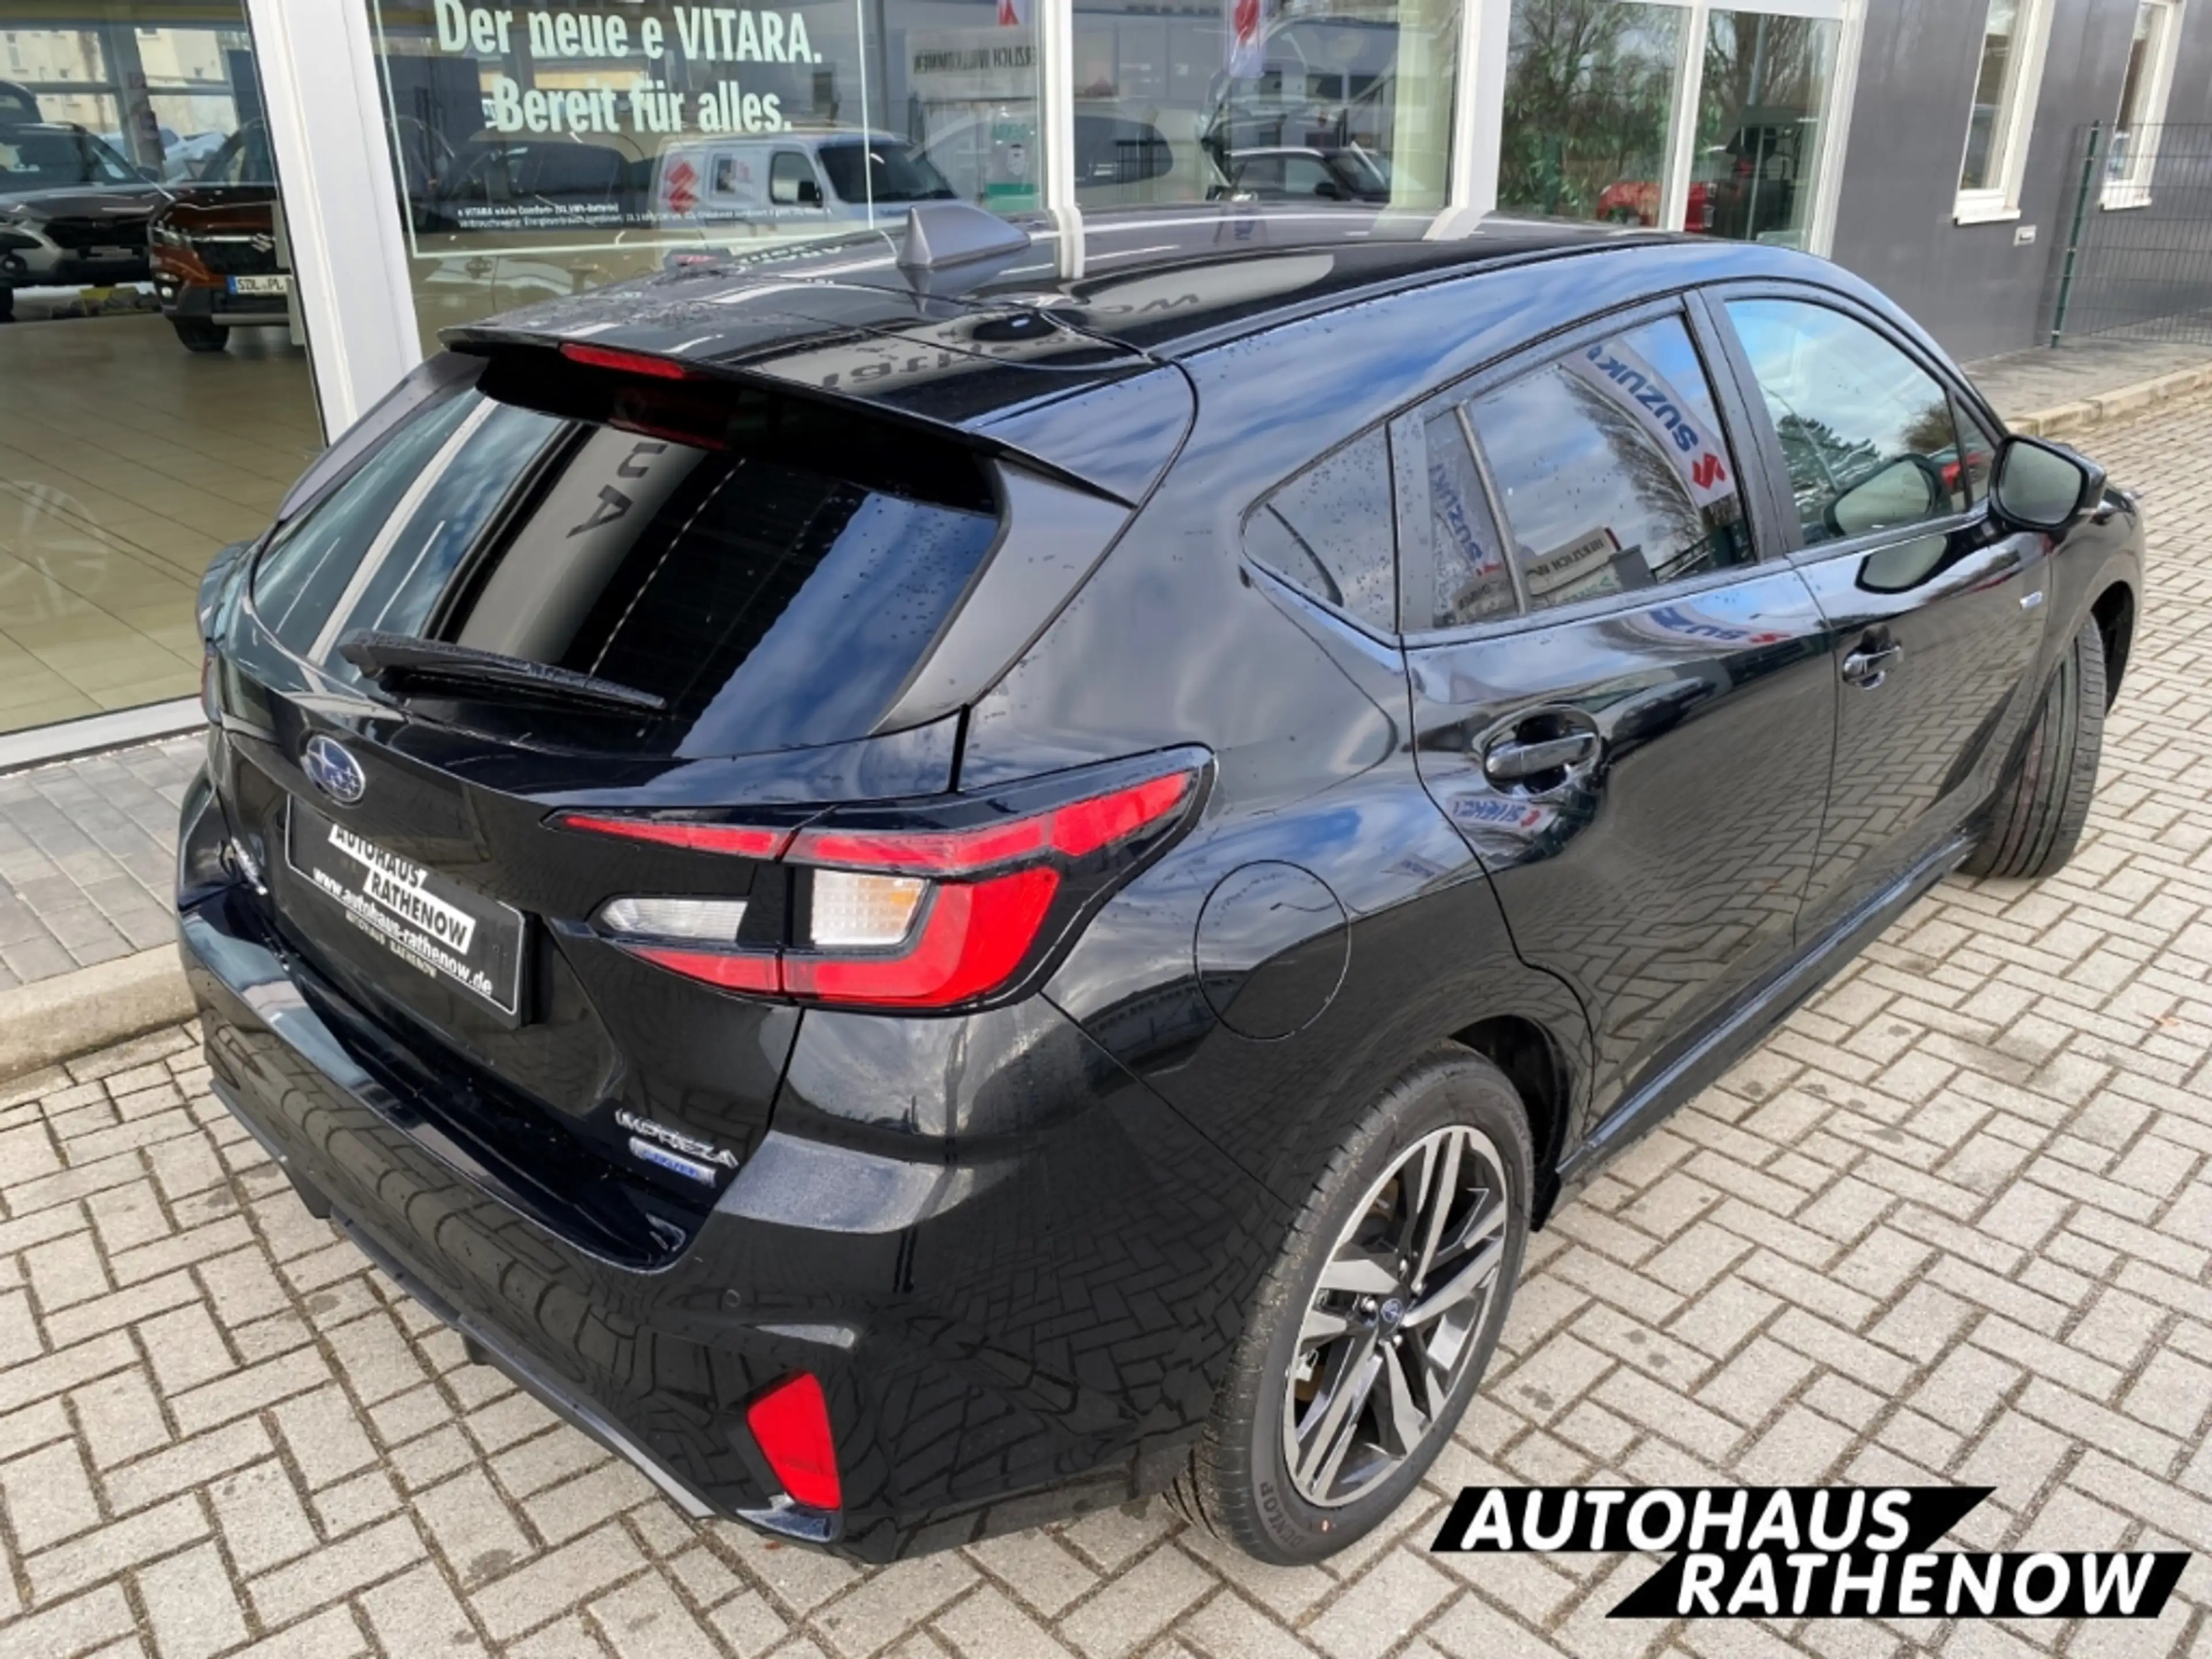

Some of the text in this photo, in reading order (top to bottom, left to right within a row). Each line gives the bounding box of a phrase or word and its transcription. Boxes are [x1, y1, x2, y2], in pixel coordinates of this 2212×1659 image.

[434, 0, 822, 63] Der neue e VITARA.
[491, 76, 792, 132] Bereit für alles.
[336, 825, 419, 889] AUTOHAUS
[313, 866, 494, 995] www.autohaus-rathenow.de
[371, 870, 468, 946] RATHENOW
